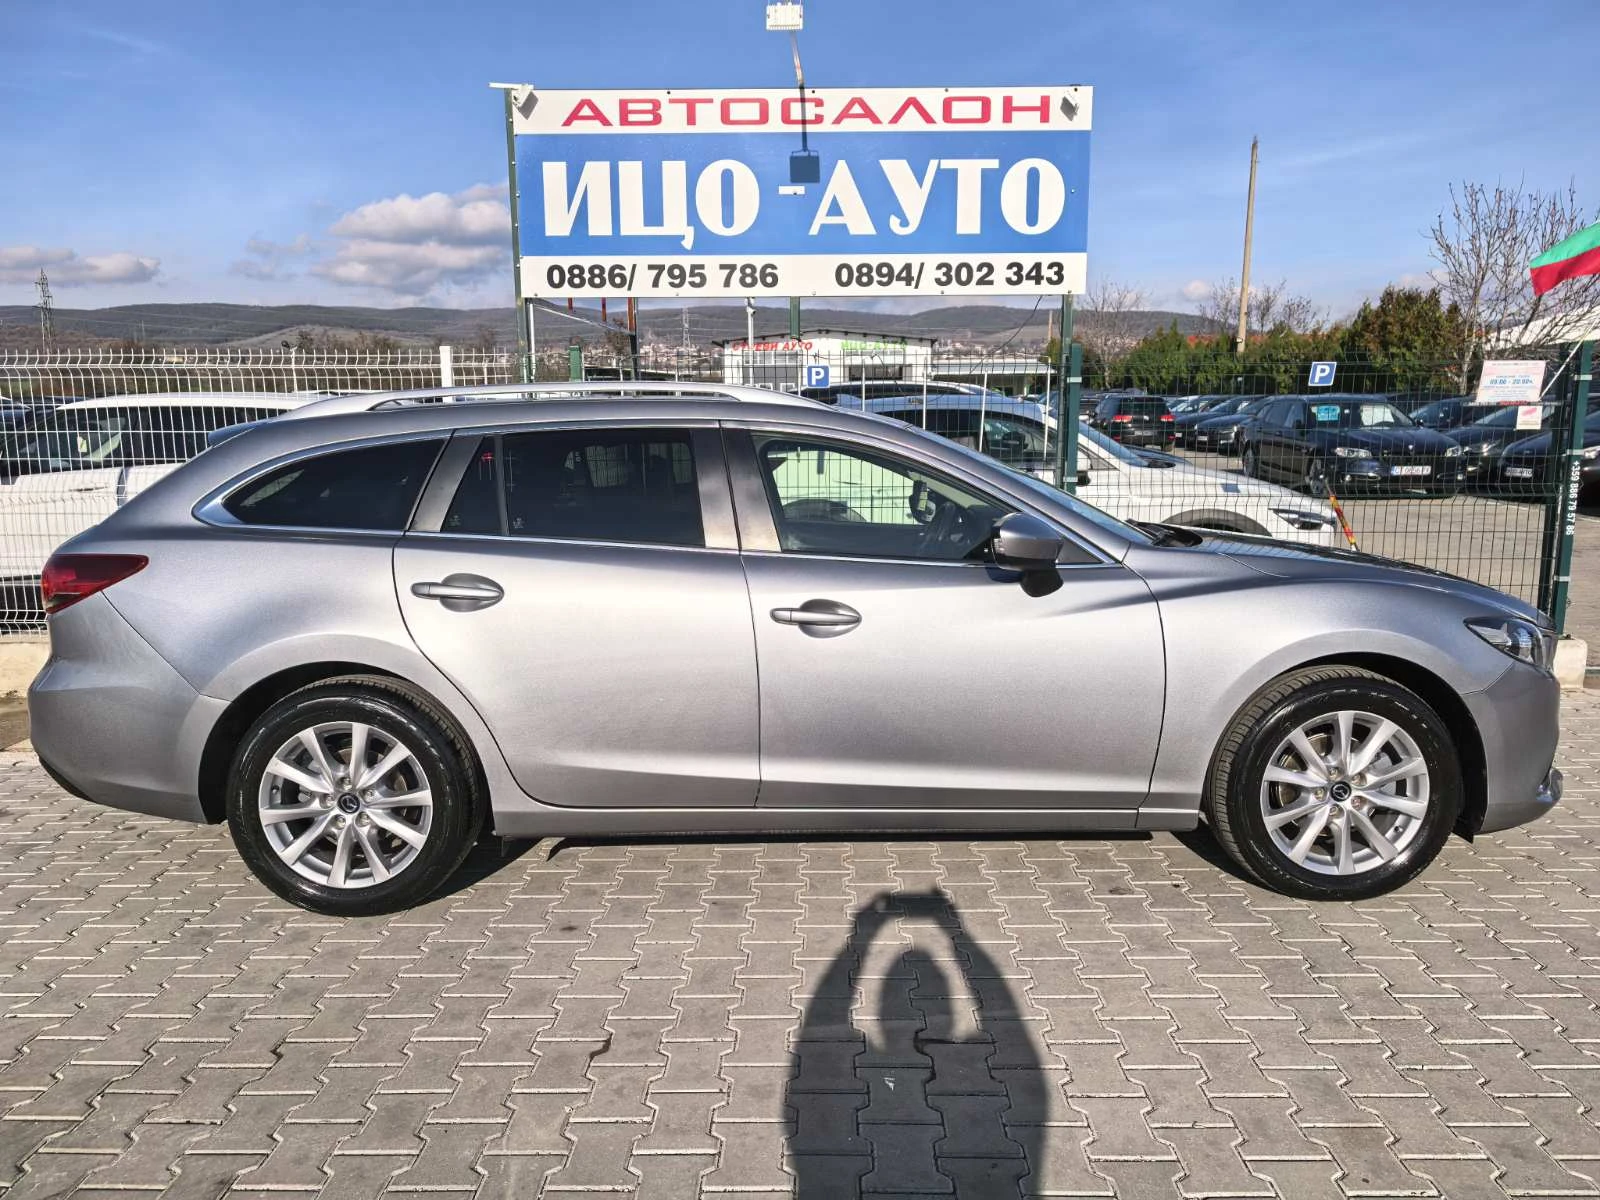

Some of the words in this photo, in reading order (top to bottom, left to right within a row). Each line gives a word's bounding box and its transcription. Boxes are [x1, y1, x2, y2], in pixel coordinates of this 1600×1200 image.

[562, 95, 1051, 127] АВТОСАЛОН
[546, 263, 637, 291] 0886/
[647, 263, 707, 289] 795
[719, 263, 779, 288] 786
[834, 262, 925, 290] 0894/
[934, 262, 995, 287] 302
[1005, 261, 1065, 286] 343
[811, 367, 825, 385] P
[1314, 364, 1331, 383] P
